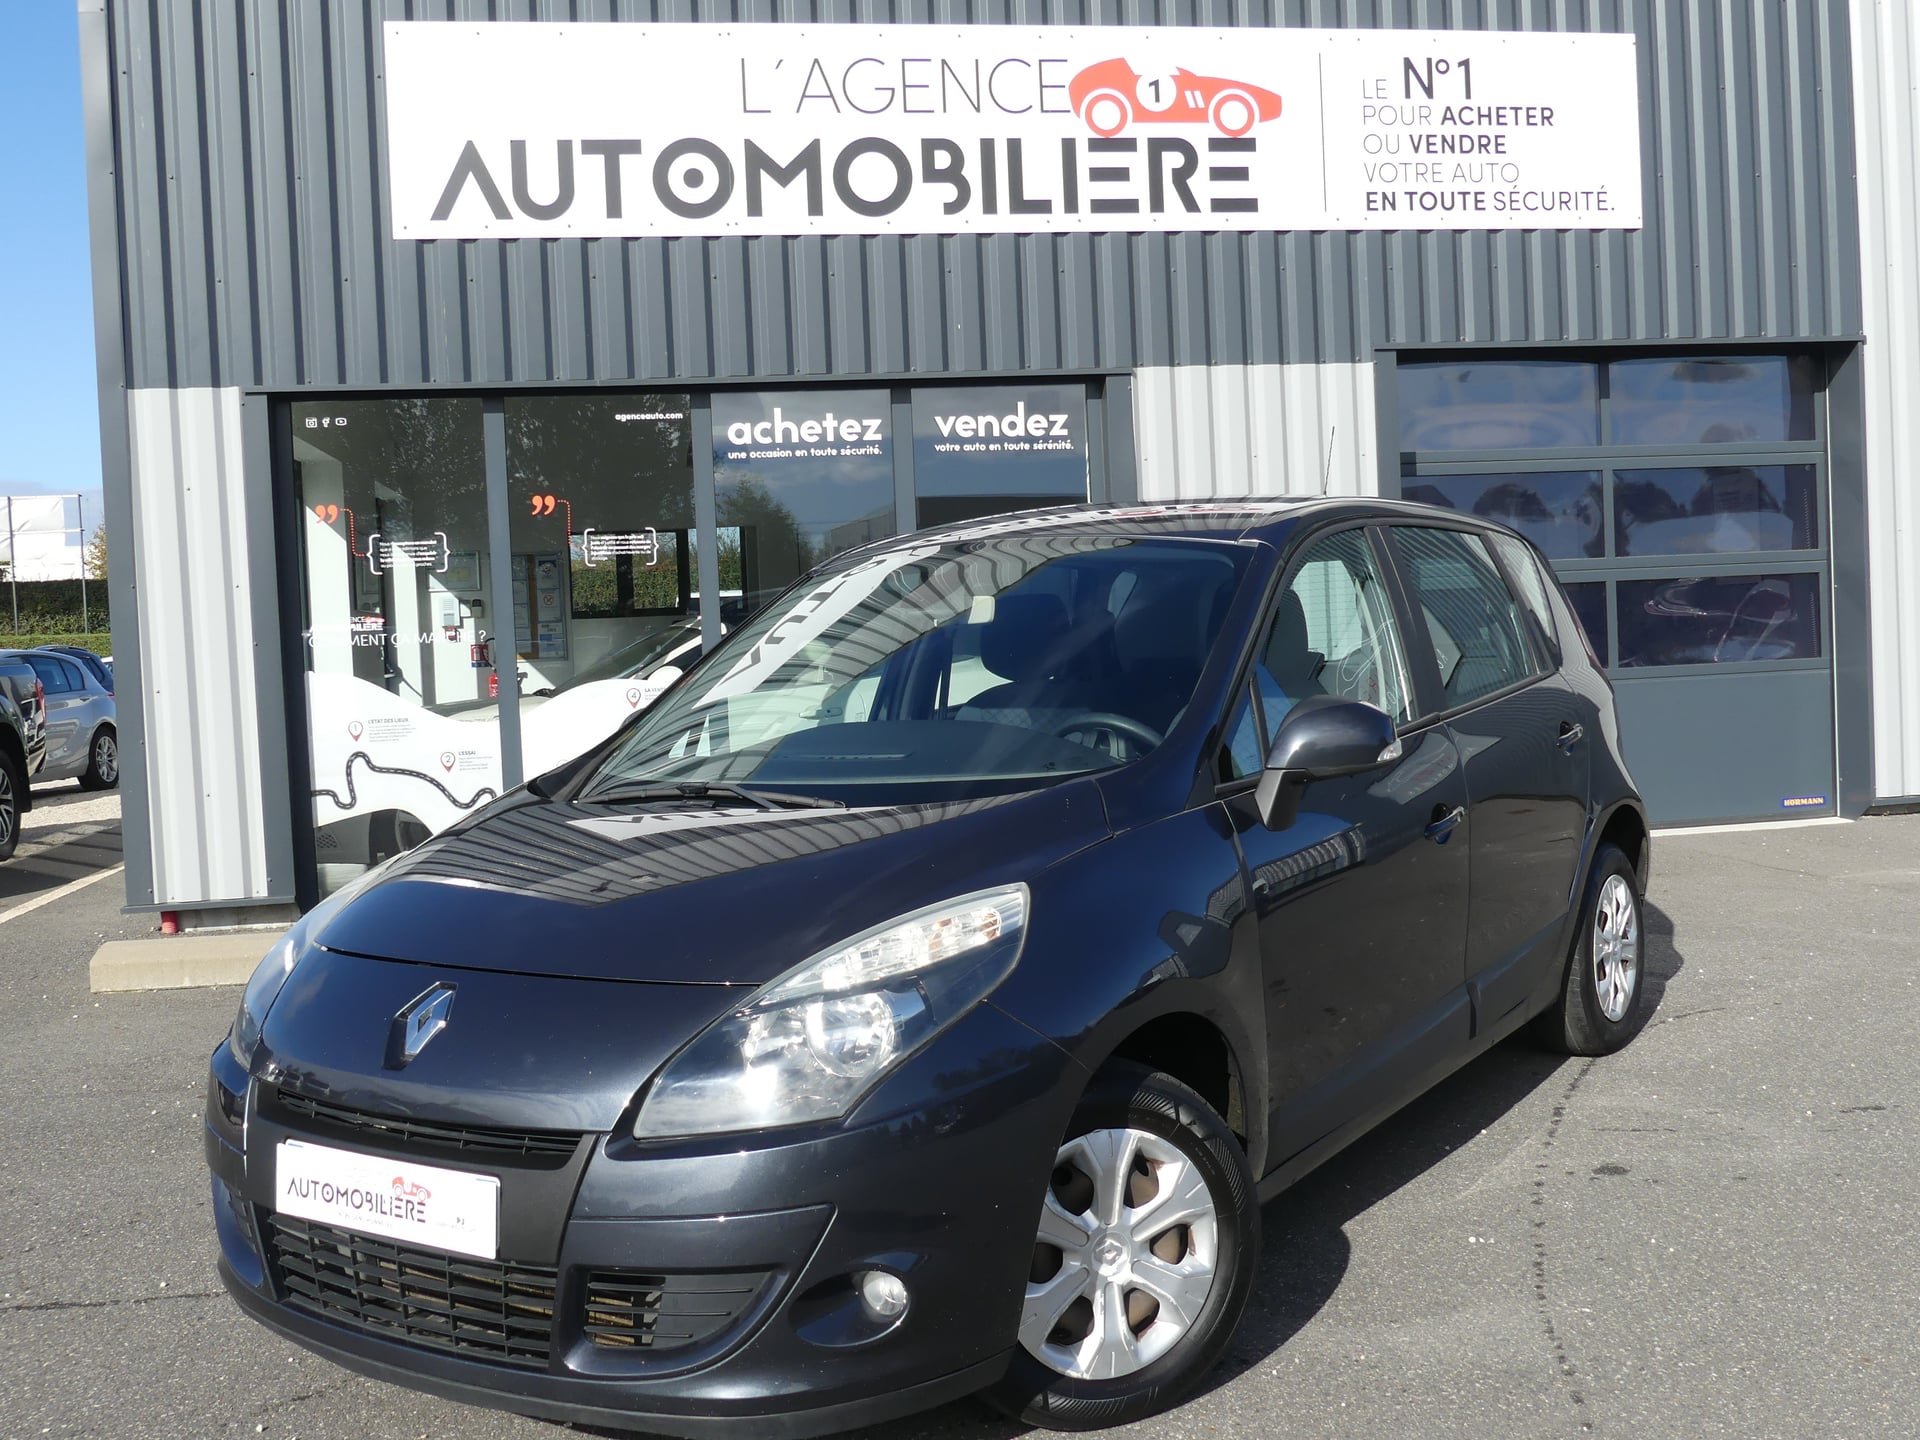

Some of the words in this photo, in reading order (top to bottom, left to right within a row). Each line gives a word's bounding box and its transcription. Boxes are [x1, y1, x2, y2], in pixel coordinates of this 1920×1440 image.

[1363, 79, 1388, 99] LE
[1363, 105, 1432, 126] POUR
[1441, 105, 1554, 126] ACHETER
[1363, 133, 1400, 155] OU
[1409, 134, 1507, 155] VENDRE
[1364, 163, 1444, 184] VOTRE
[1452, 163, 1519, 184] AUTO
[1366, 191, 1397, 211] EN
[1404, 191, 1486, 211] TOUTE
[1493, 186, 1615, 212] SÉCURITÉ.
[615, 412, 683, 422] agenceauto.com
[727, 407, 883, 446] achetez
[934, 401, 1069, 438] vendez
[728, 451, 747, 459] une
[750, 448, 792, 459] occasion
[810, 447, 837, 457] toute
[840, 444, 883, 456] sécurité.
[935, 443, 960, 452] votre
[963, 442, 986, 451] auto
[989, 443, 1001, 451] en
[1004, 441, 1030, 451] toute
[1033, 439, 1074, 450] sérénité.
